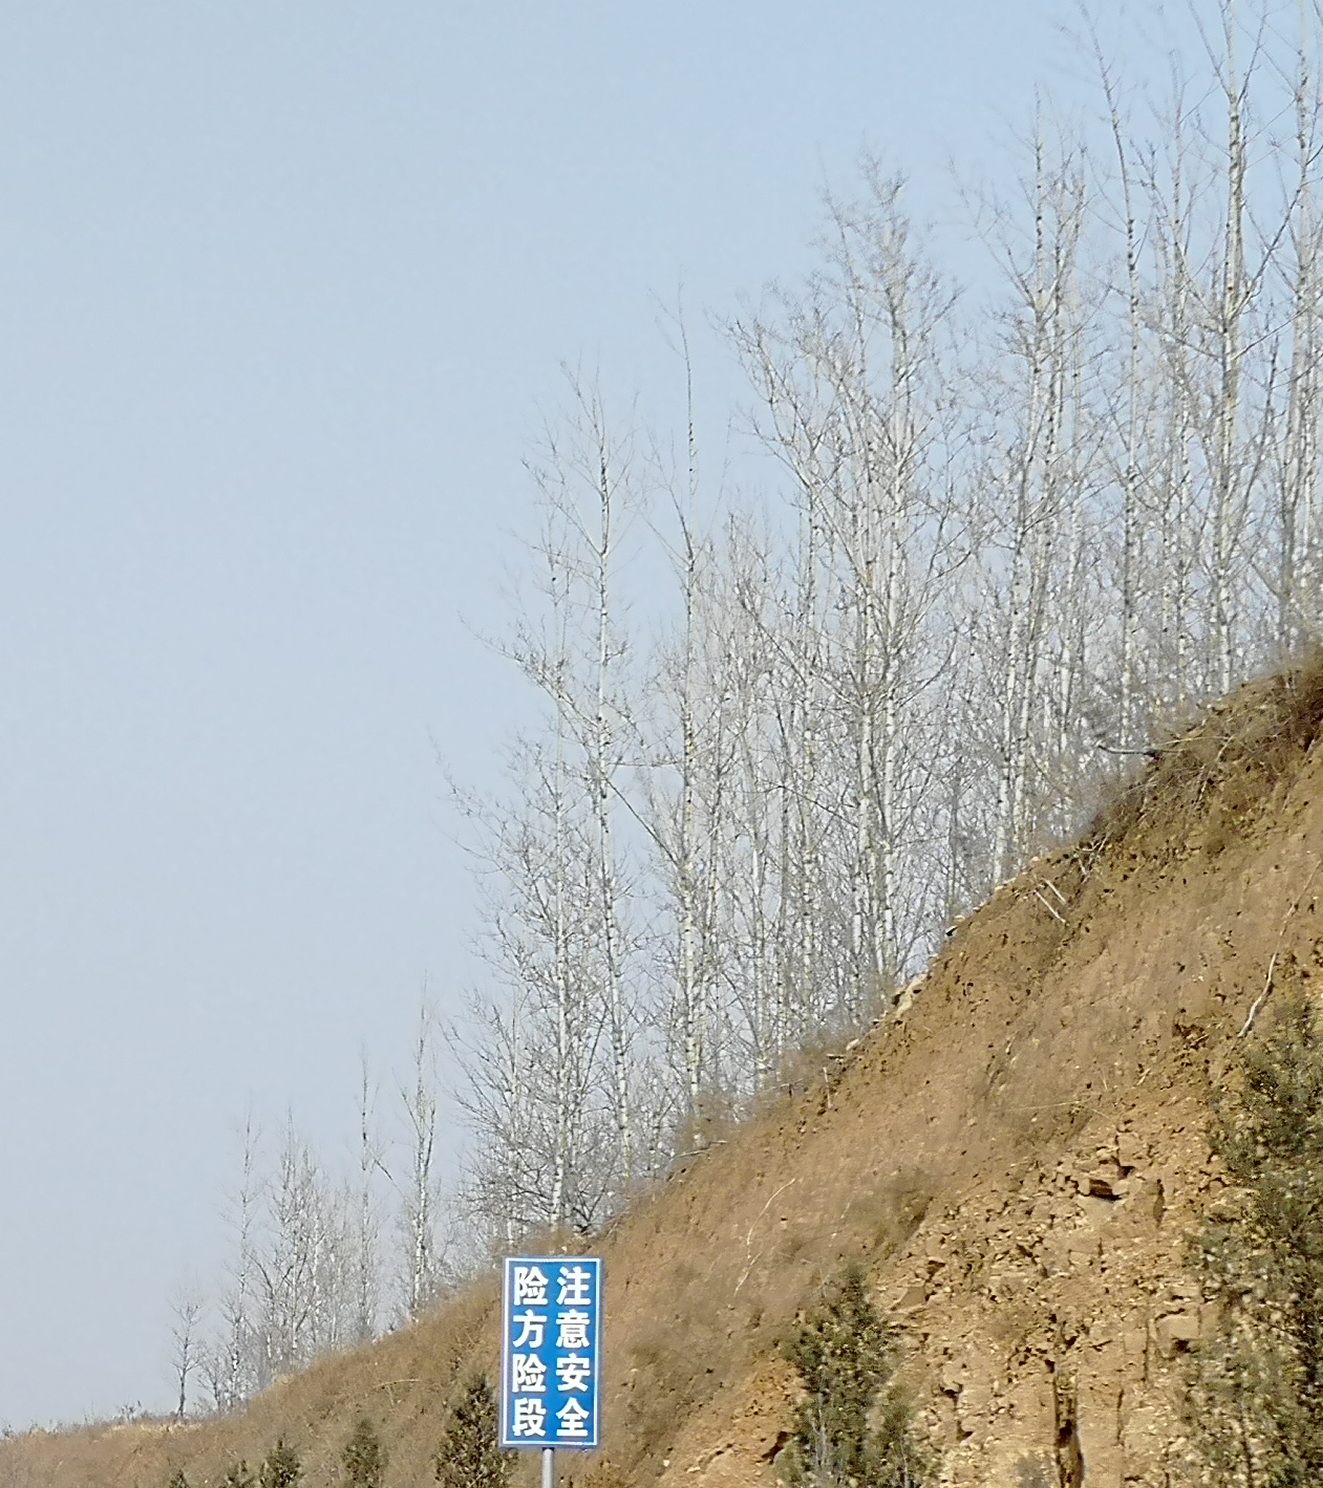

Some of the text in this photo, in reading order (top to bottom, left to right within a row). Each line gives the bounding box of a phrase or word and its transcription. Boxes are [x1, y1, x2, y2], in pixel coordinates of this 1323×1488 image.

[512, 1266, 548, 1437] 险方险段
[556, 1266, 592, 1437] 注意安全
